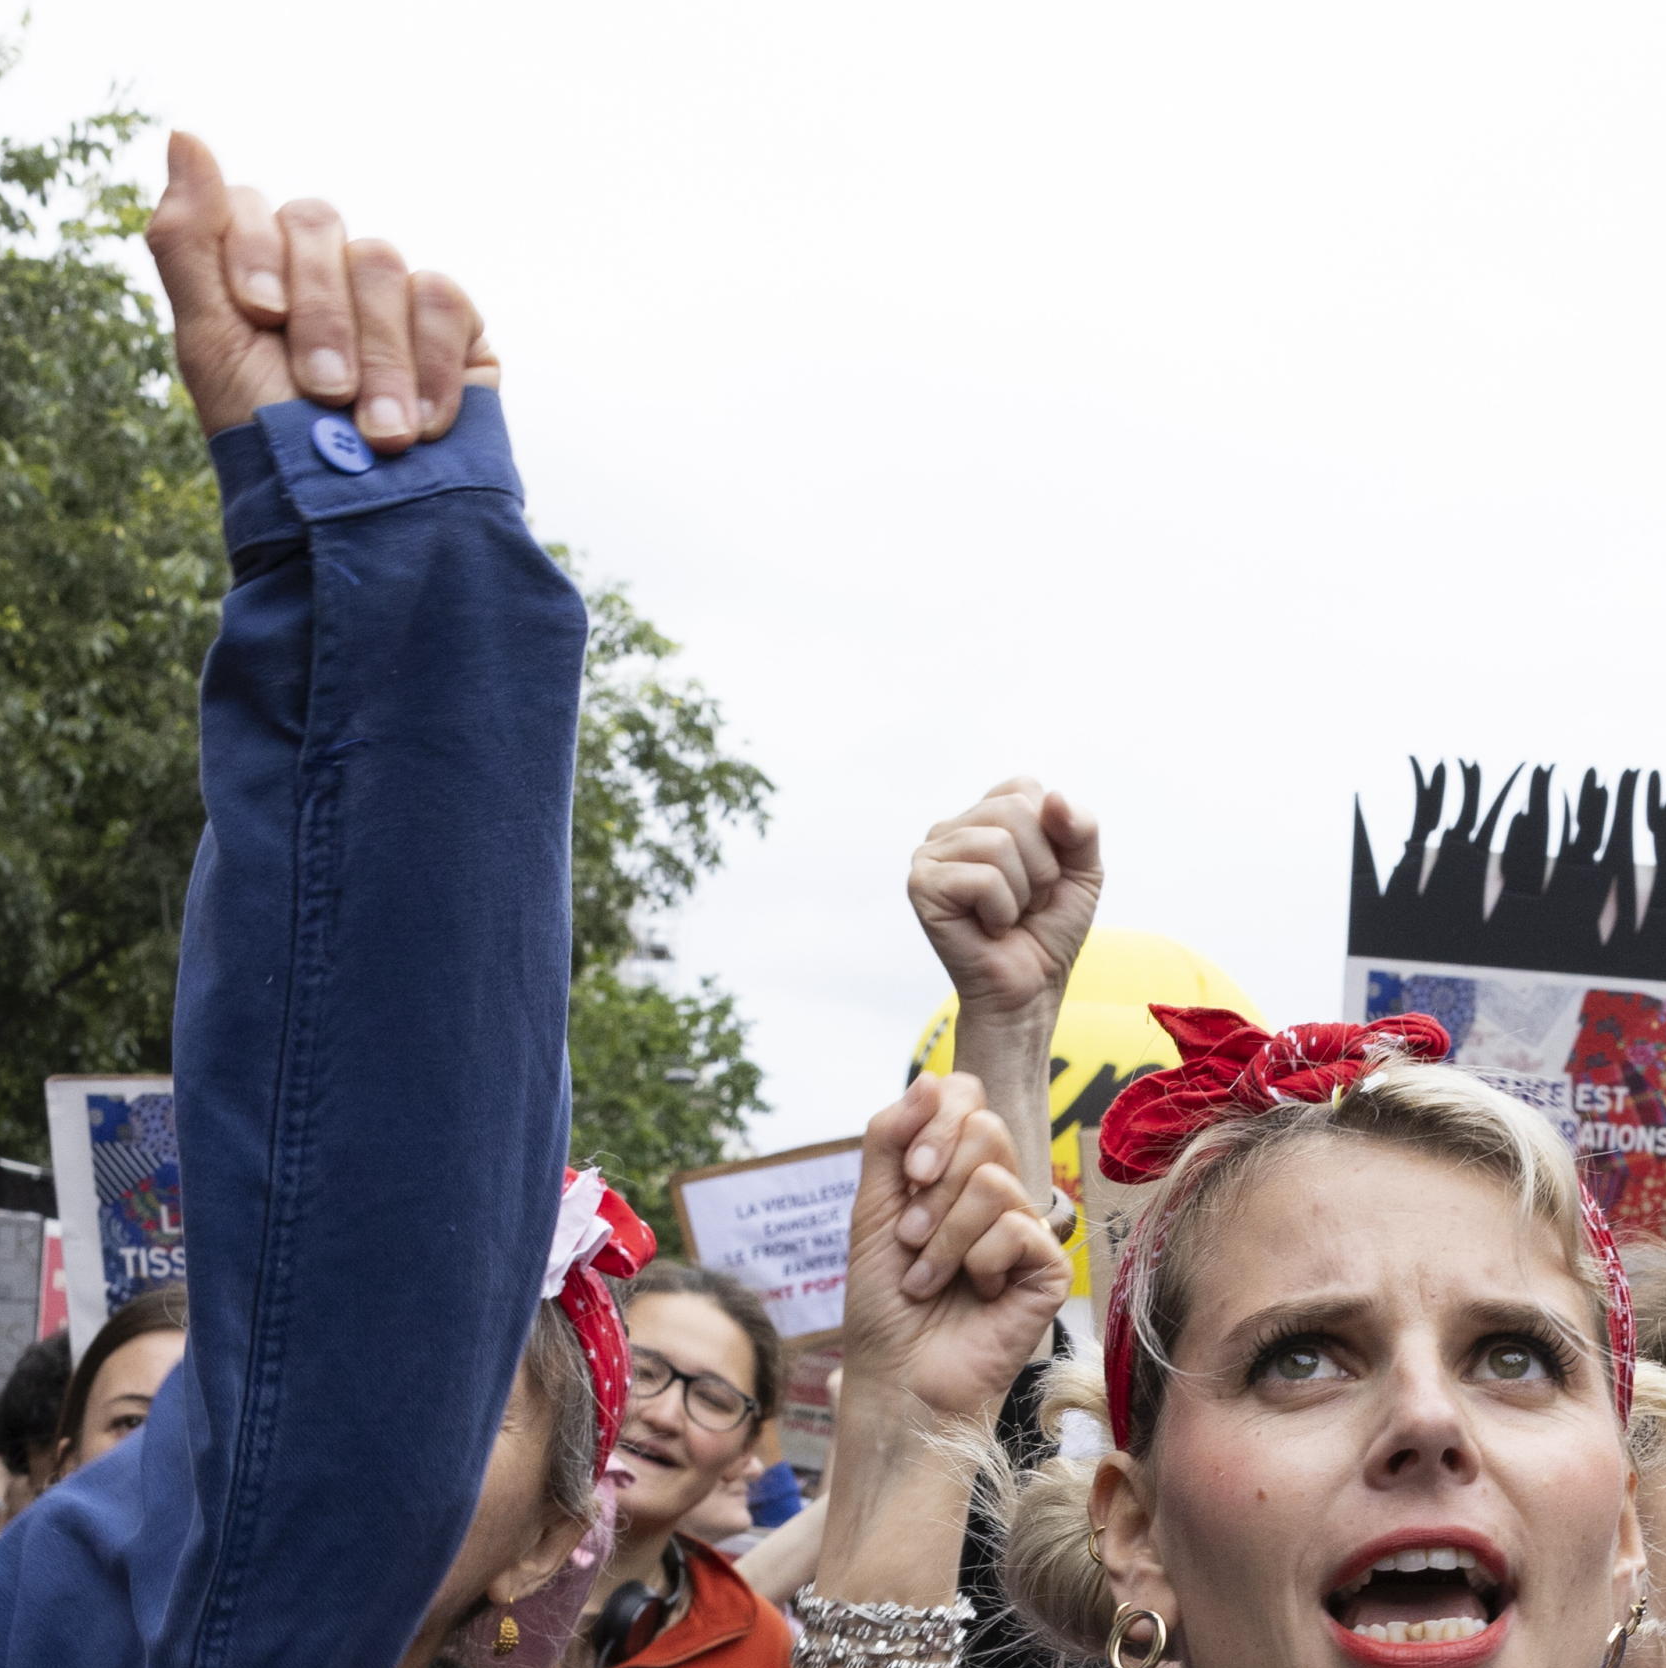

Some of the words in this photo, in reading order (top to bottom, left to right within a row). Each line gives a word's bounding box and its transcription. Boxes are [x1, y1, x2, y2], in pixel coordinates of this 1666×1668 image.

[1575, 1083, 1629, 1114] EST
[811, 1227, 848, 1248] NAT
[118, 1246, 186, 1278] TISS
[801, 1273, 847, 1296] POP
